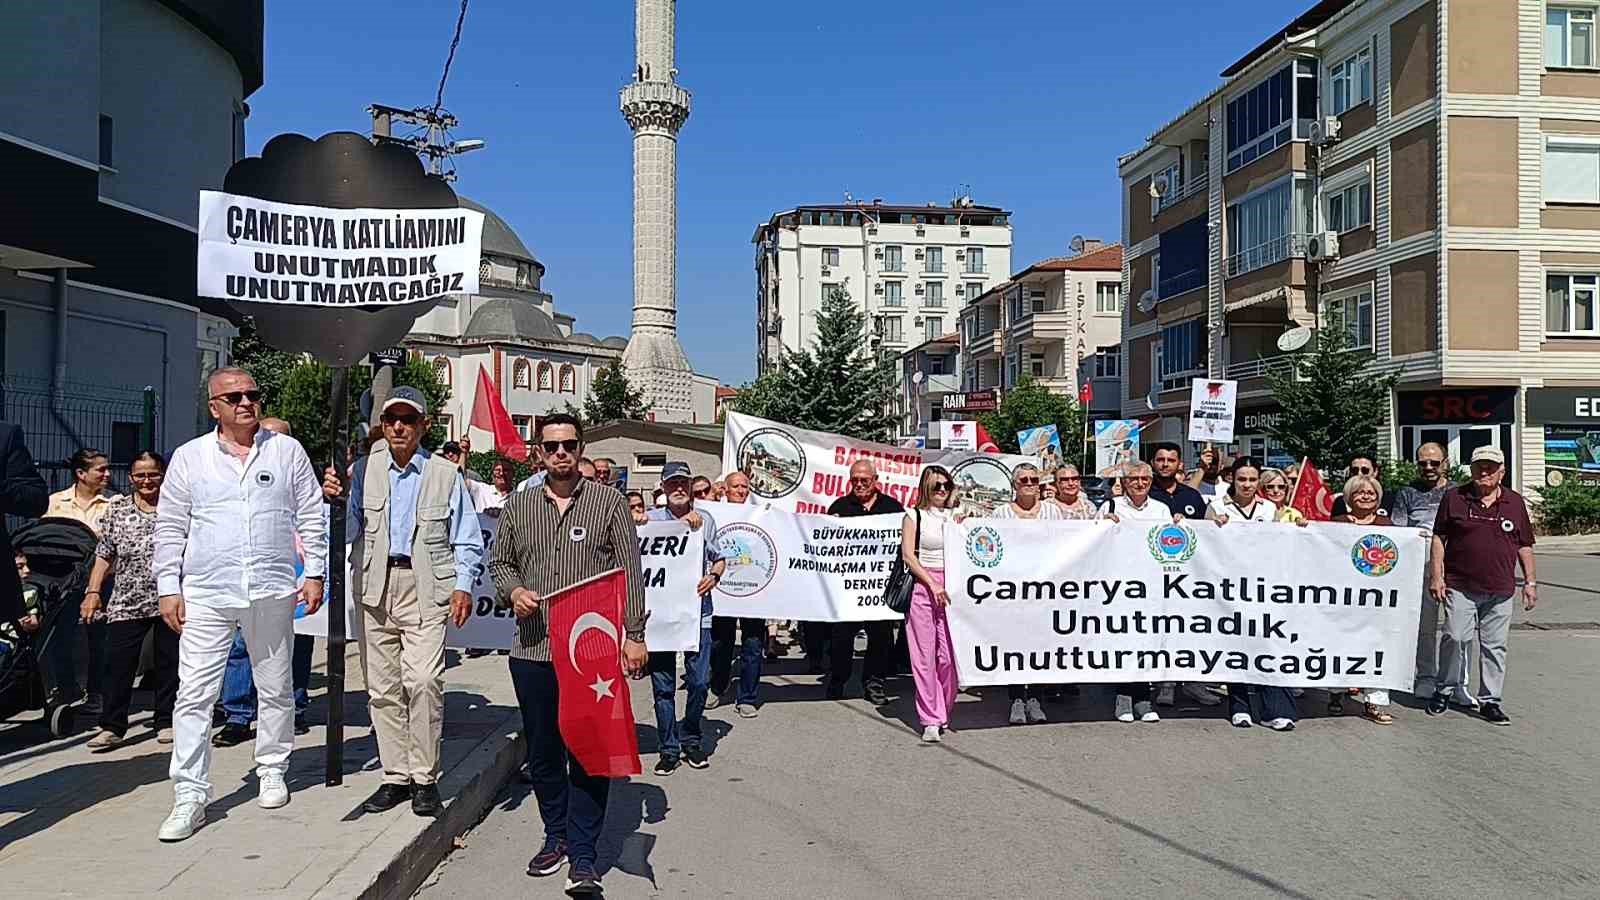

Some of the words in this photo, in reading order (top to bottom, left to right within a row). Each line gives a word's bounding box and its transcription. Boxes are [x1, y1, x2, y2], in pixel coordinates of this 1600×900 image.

[226, 205, 338, 249] ÇAMERYA
[343, 214, 466, 250] KATLİAMINI
[254, 252, 437, 279] UNUTMADIK
[226, 272, 464, 304] UNUTMAYACAĞIZ
[1244, 411, 1281, 429] EDİRNE
[1424, 395, 1491, 420] SRC
[813, 526, 902, 541] BÜYÜKKARIŞTIR
[803, 543, 878, 557] BULGARİSTAN
[788, 557, 866, 576] YARDIMLAŞMA
[870, 561, 884, 572] VE
[966, 574, 1147, 606] Çamerya
[1163, 574, 1398, 608] Katliamını
[1052, 609, 1299, 643] Unutmadık,
[974, 645, 1385, 681] Unutturmayacağız!
